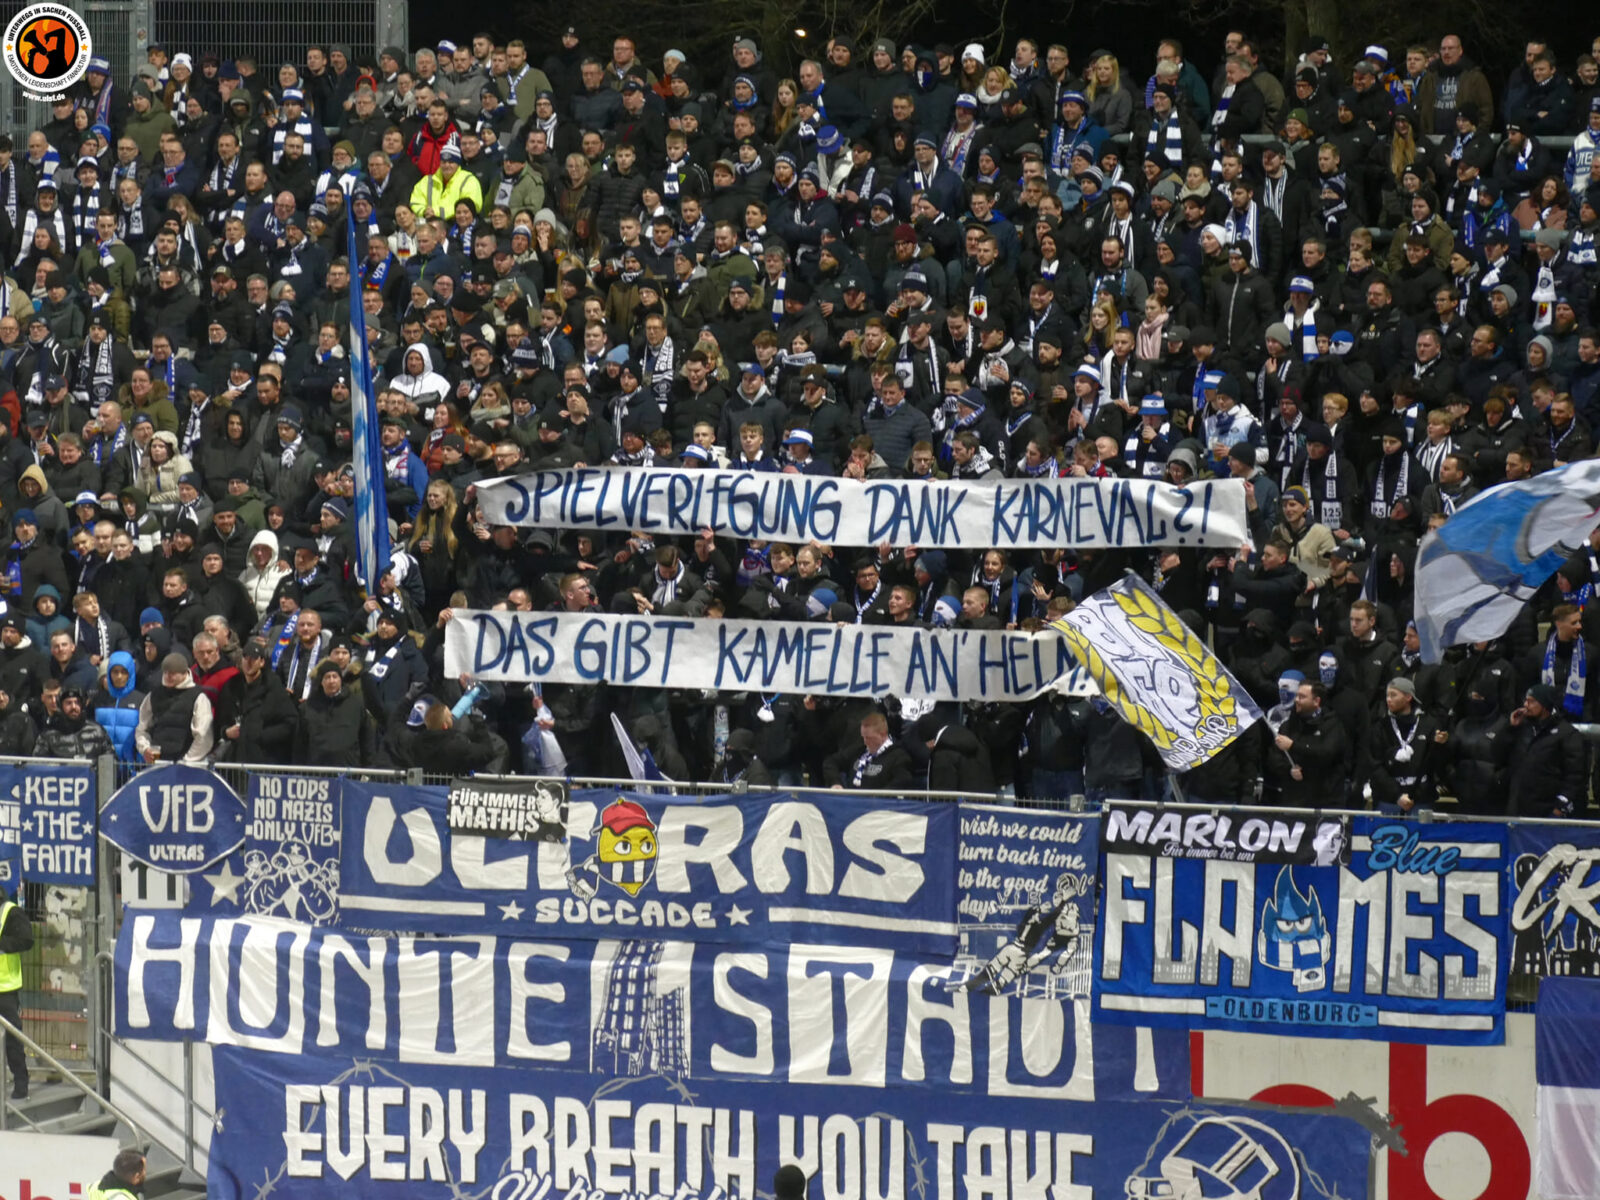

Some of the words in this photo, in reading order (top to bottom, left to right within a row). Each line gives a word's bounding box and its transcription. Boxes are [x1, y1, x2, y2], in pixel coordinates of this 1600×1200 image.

[503, 468, 842, 542] SPIELVERLEGUNG
[864, 484, 968, 544] DANK
[992, 482, 1213, 546] KARNEVAL?!
[471, 613, 559, 677] DAS
[573, 618, 695, 684] GIBT
[715, 624, 893, 693] KAMELLE
[904, 631, 969, 698] AN'
[25, 776, 89, 806] KEEP
[259, 776, 282, 798] NO
[287, 778, 329, 801] COPS
[451, 788, 479, 806] FÜR
[482, 792, 536, 810] IMMER
[139, 784, 215, 833] VfB
[254, 797, 276, 819] NO
[282, 799, 333, 823] NAZIS
[450, 805, 540, 833] MATHIS
[33, 810, 83, 840] THE
[253, 820, 296, 841] ONLY
[301, 822, 334, 846] VfB
[1002, 823, 1028, 839] we
[1029, 822, 1083, 844] could
[1105, 809, 1306, 853] MARLON
[22, 843, 92, 875] FAITH
[149, 844, 205, 861] ULTRAS
[959, 841, 995, 861] turn
[996, 843, 1041, 866] back
[1043, 848, 1086, 870] time,
[1161, 841, 1184, 856] Für
[1186, 846, 1218, 860] immer
[1219, 847, 1236, 860] bei
[1237, 851, 1255, 862] uns
[1368, 824, 1461, 876] Blue
[958, 867, 975, 889] to
[976, 866, 1001, 889] the
[1003, 874, 1049, 897] good
[535, 898, 717, 927] SUCCADE
[1101, 852, 1500, 1000] FLAMES
[282, 1083, 488, 1183] EVERY
[507, 1093, 757, 1200] BREATH
[778, 1111, 905, 1200] YOU
[926, 1122, 1094, 1200] TAKE
